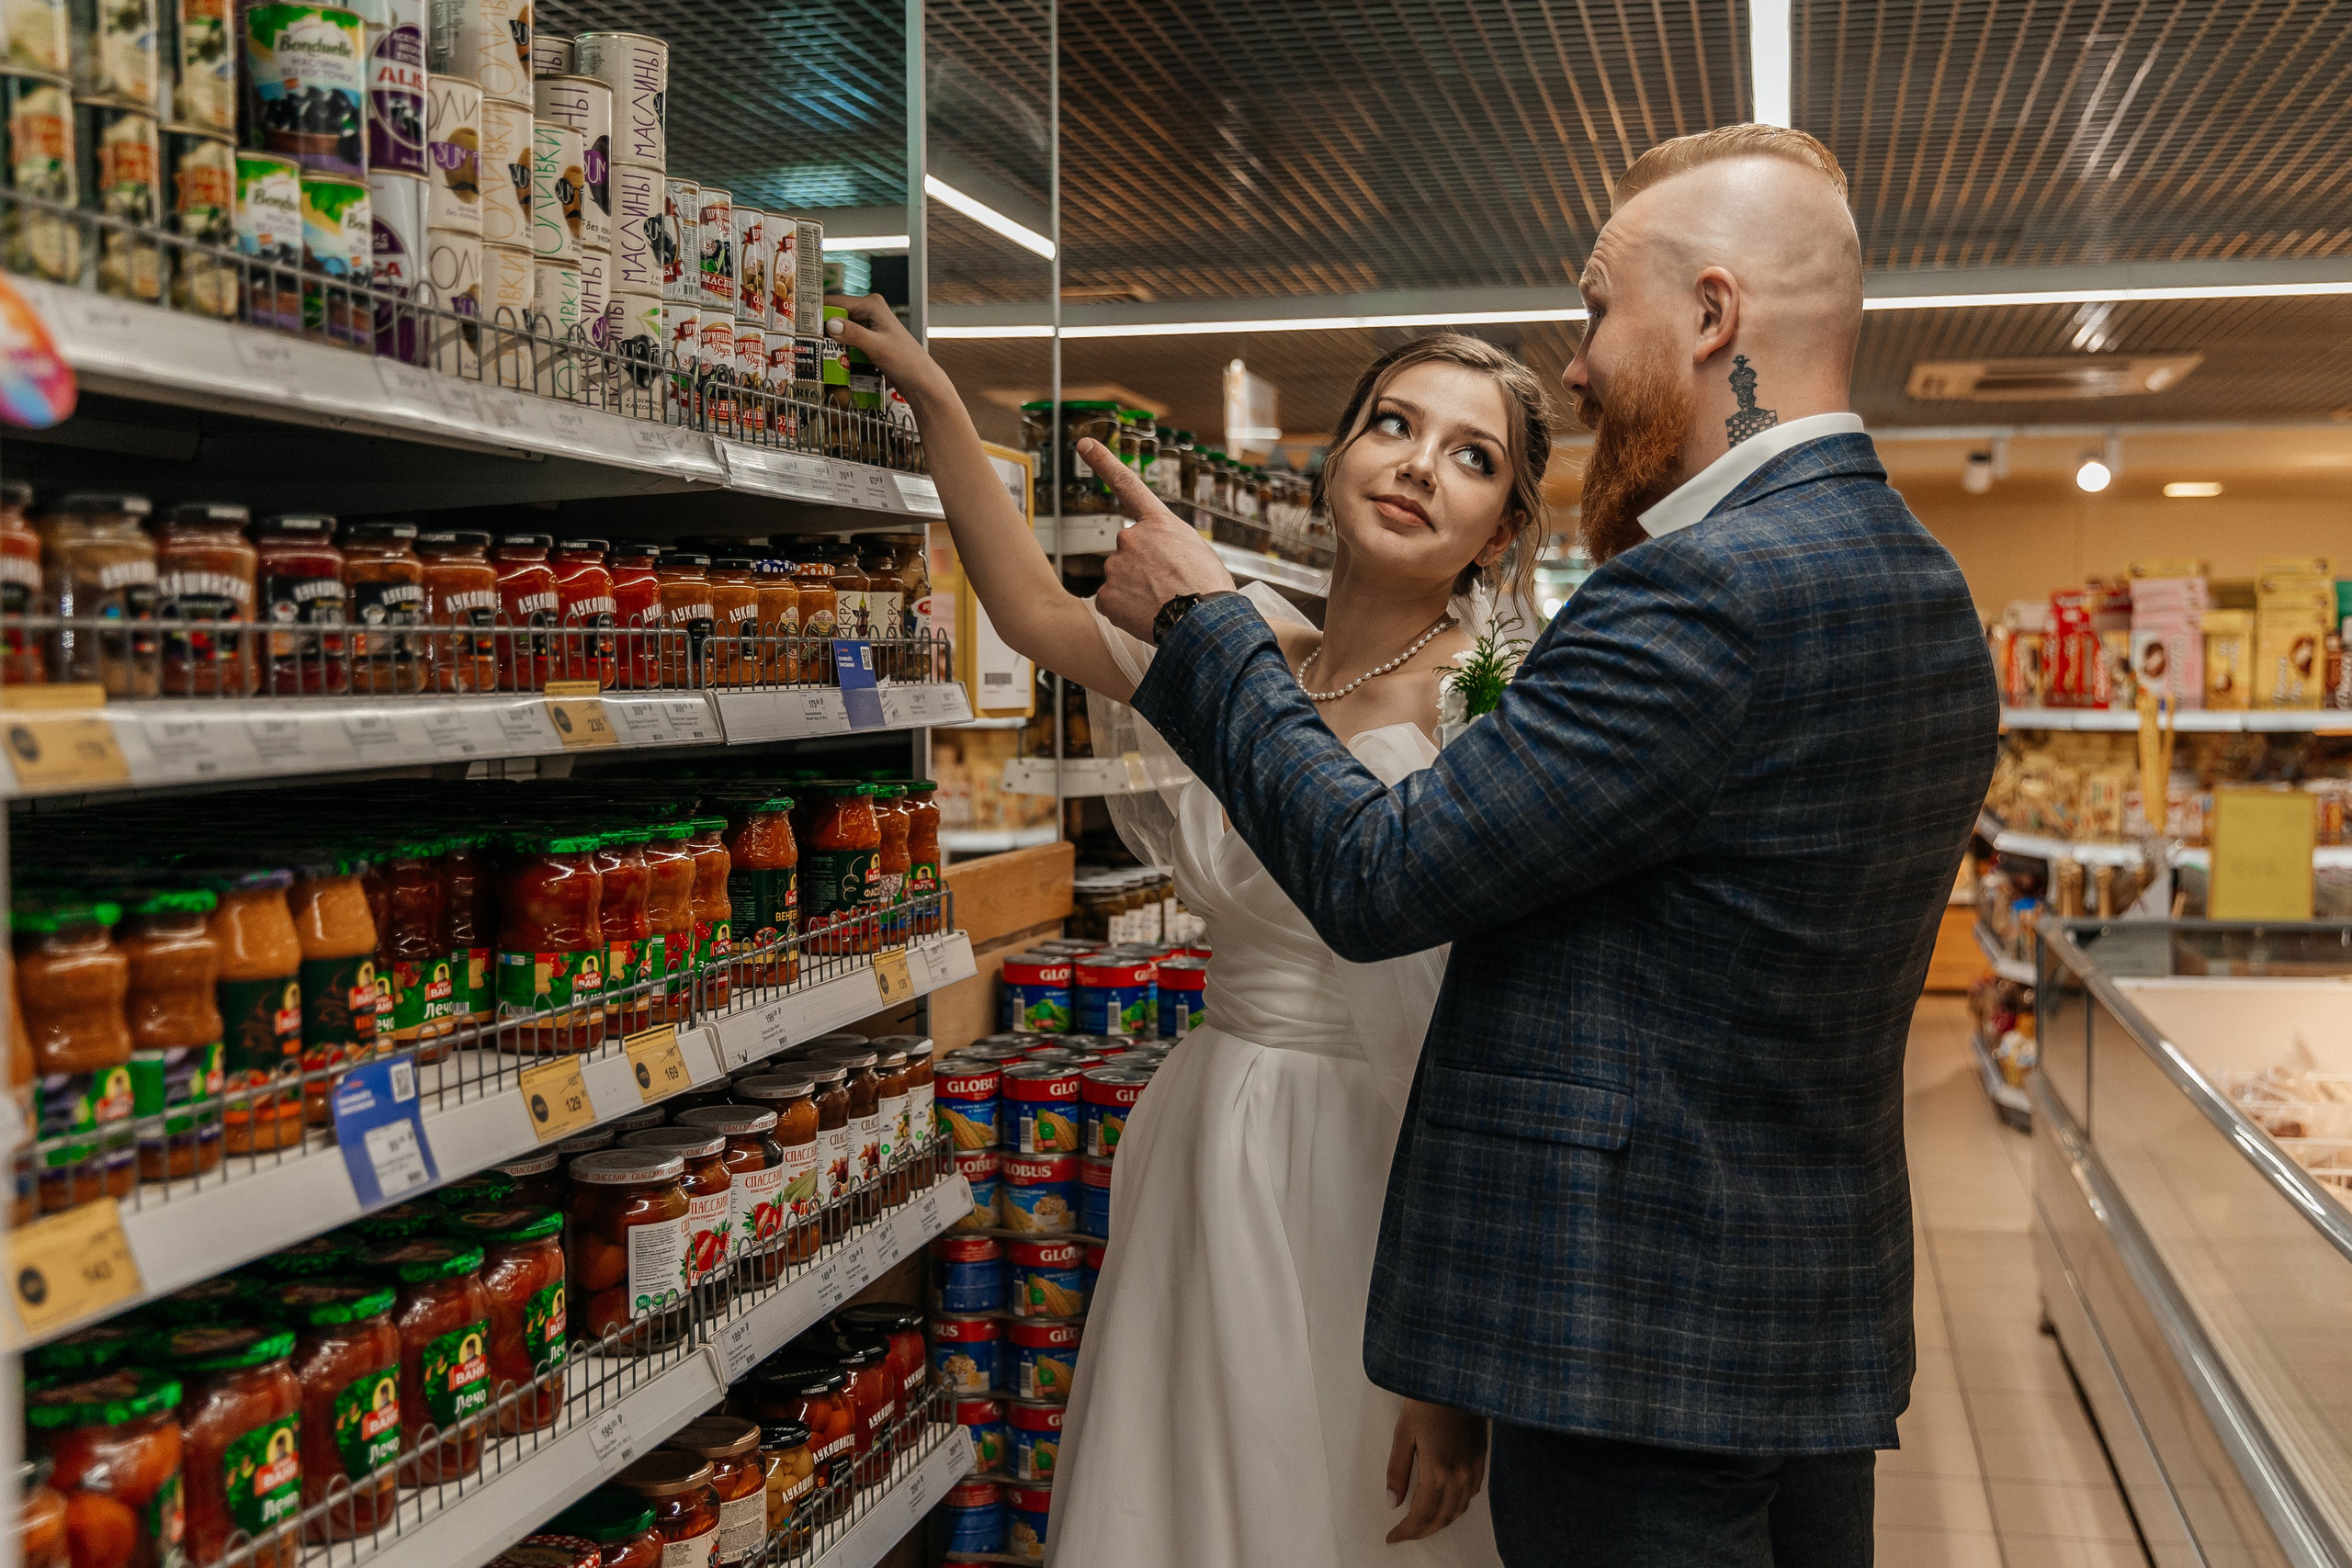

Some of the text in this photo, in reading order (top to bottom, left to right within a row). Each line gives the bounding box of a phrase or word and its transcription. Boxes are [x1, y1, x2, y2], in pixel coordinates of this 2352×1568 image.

[632, 48, 660, 159] МАСЛИНЫ
[620, 174, 651, 285] МАСЛИНЫ
[376, 1016, 396, 1033] ечо
[664, 1066, 679, 1081] 169
[565, 1095, 582, 1113] 129
[723, 1122, 754, 1134] СПАССКИЙ
[686, 1145, 716, 1156] СПАССКИЙ
[593, 1172, 627, 1182] СПАССКИЙ
[631, 1168, 665, 1180] СПАССКИЙ
[455, 1363, 487, 1385] ВАНЯ
[453, 1386, 487, 1415] Лечо
[601, 1426, 614, 1440] 195
